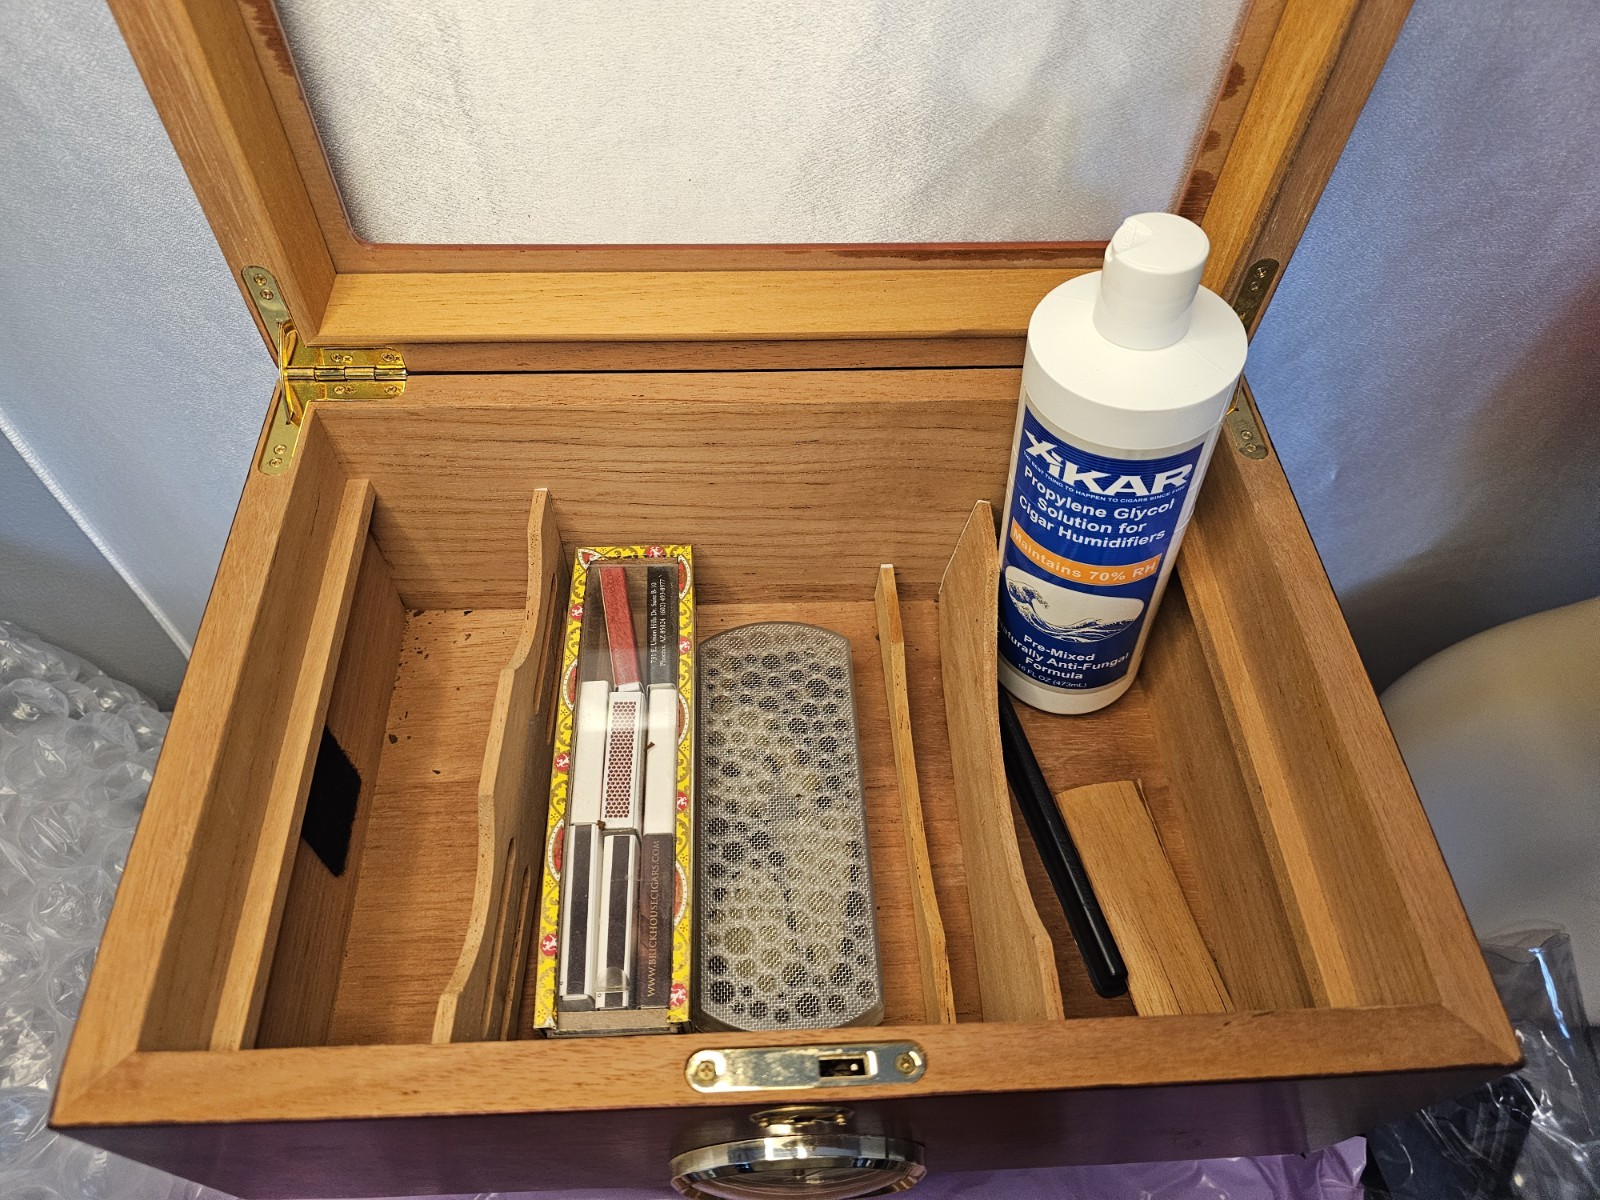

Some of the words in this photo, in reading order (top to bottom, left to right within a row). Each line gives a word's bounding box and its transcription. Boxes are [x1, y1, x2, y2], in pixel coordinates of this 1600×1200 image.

[1024, 465, 1107, 518] Propylene
[1113, 498, 1175, 521] Glycol
[1045, 473, 1064, 488] THING
[1065, 485, 1075, 493] TO
[1075, 489, 1106, 501] HAPPEN
[1150, 491, 1171, 501] SINCE
[1019, 495, 1055, 531] Cigar
[1058, 526, 1166, 548] Humidifiers
[1037, 497, 1112, 534] Solution
[1119, 522, 1147, 534] for
[1013, 528, 1082, 578] Maintains
[1089, 571, 1126, 581] 70%
[1132, 562, 1156, 578] RH
[1023, 634, 1096, 661] Pre-Mixed
[1047, 652, 1129, 671] Anti-Fungal
[1025, 656, 1083, 679] Formula
[1027, 669, 1037, 678] FL
[1052, 679, 1087, 688] (473mL)
[646, 840, 660, 998] WWW.BRICKHOUSECIGARS.COM
